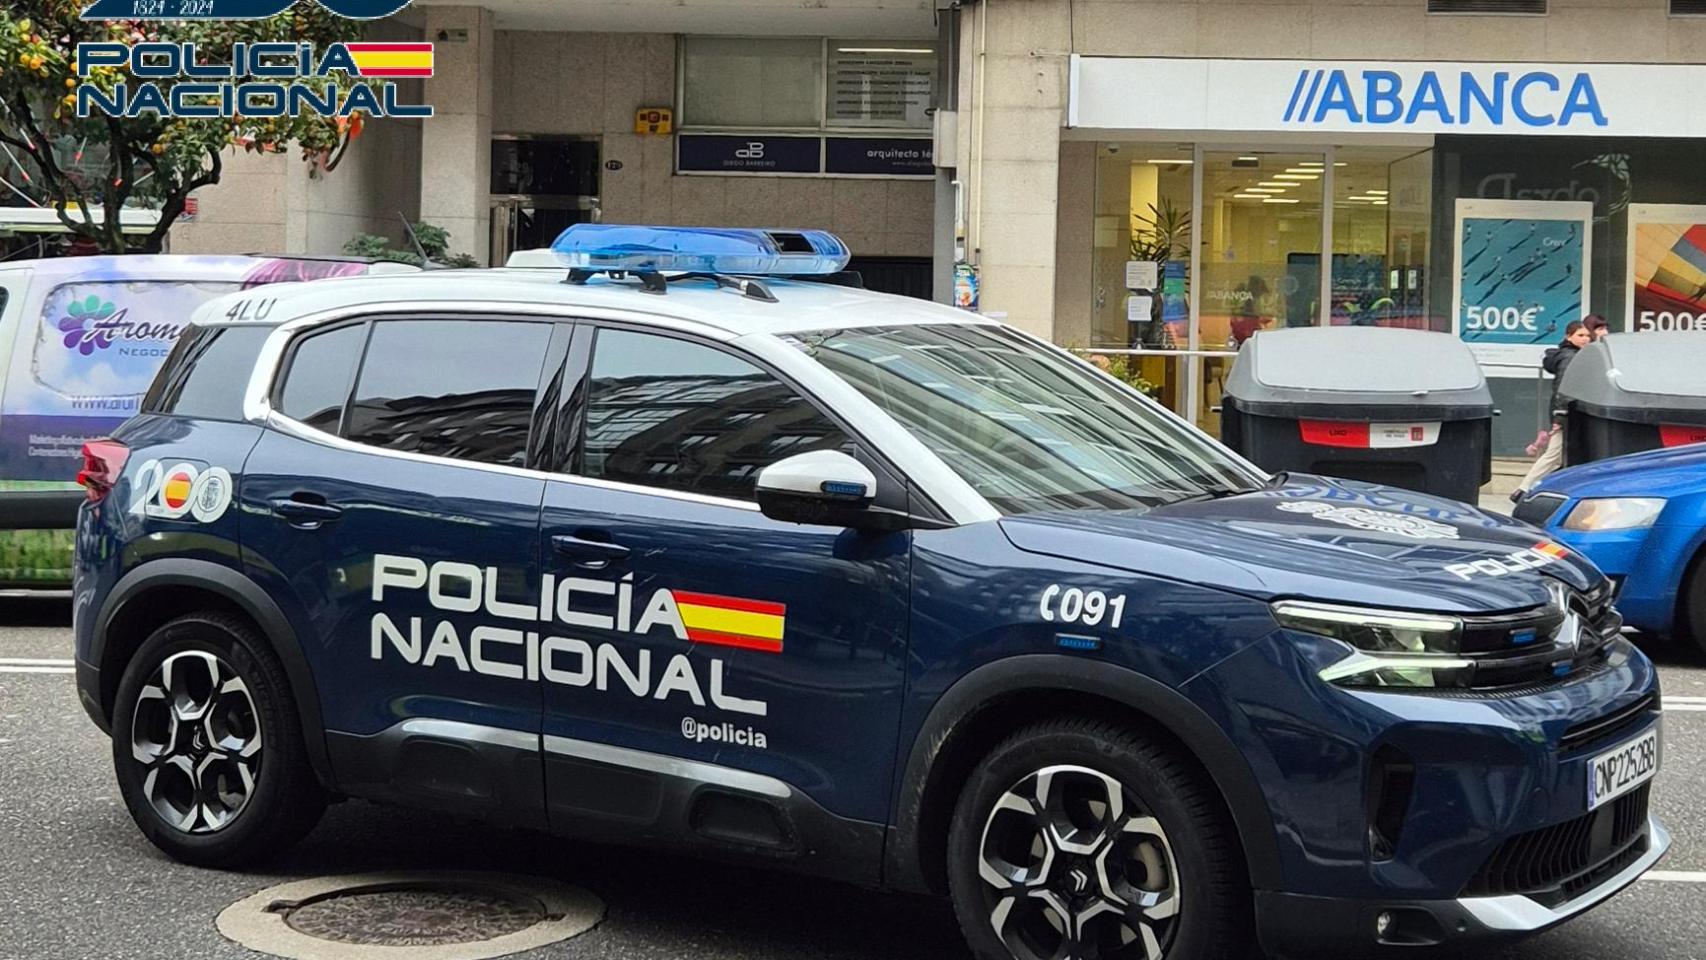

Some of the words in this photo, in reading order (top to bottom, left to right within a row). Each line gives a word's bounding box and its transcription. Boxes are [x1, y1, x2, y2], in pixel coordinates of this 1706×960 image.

[867, 148, 919, 160] arquitecto
[225, 298, 277, 321] 4LU
[128, 459, 233, 523] 200
[371, 553, 690, 640] POLICÍA
[1060, 587, 1127, 629] 091
[371, 611, 768, 717] NACIONAL
[681, 716, 768, 749] @policia
